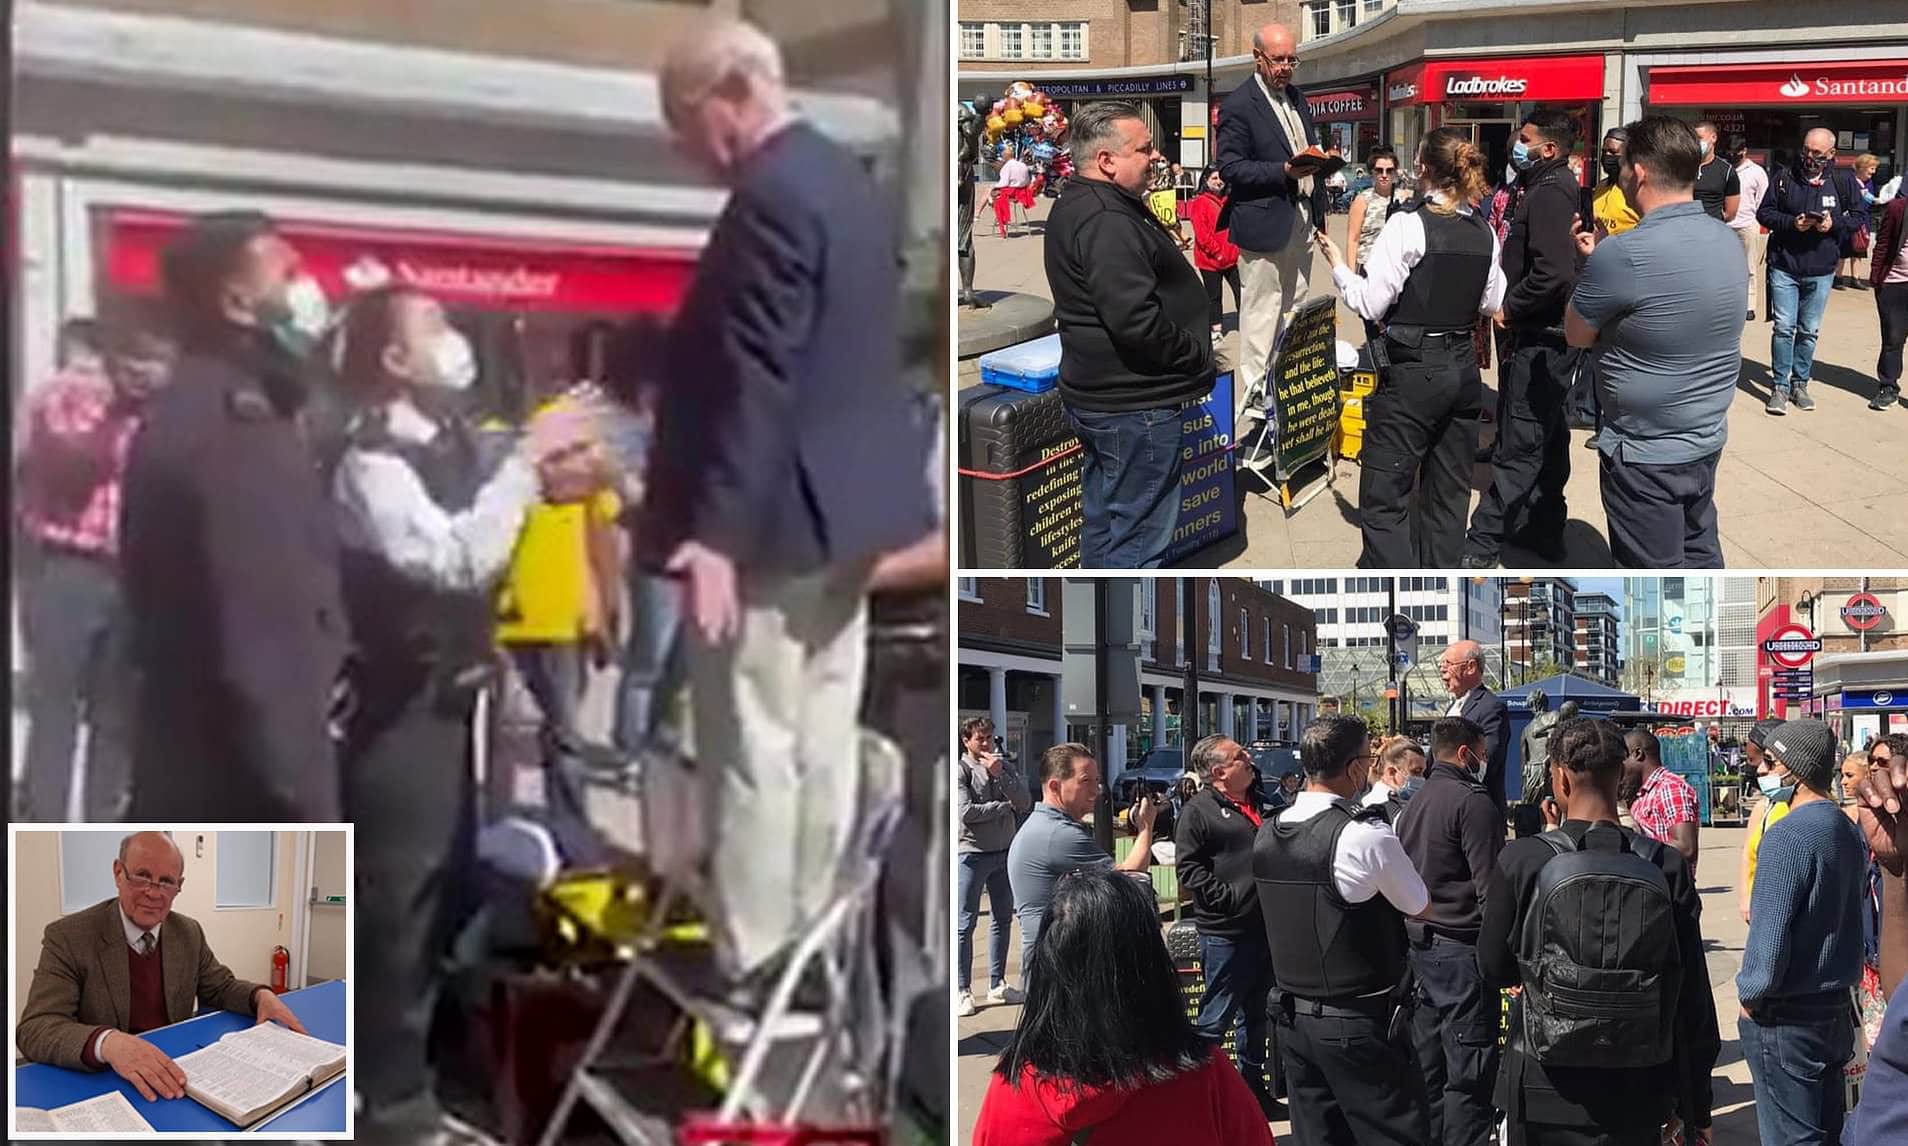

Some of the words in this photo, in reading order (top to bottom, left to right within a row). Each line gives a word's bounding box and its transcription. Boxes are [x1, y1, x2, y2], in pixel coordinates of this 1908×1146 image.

[1033, 85, 1089, 94] ETROPOLITAN
[1107, 82, 1150, 93] PICCADILLY
[1156, 80, 1177, 91] LINES
[1446, 75, 1527, 94] Ladbrokes
[1328, 99, 1363, 114] COFFEE
[1284, 362, 1299, 380] and
[1299, 360, 1312, 374] the
[1312, 355, 1326, 370] life:
[1278, 387, 1290, 400] he
[1289, 381, 1305, 397] that
[1304, 368, 1337, 390] believeth
[1287, 403, 1296, 417] in
[1297, 400, 1312, 413] me,
[1299, 414, 1317, 429] were
[1183, 414, 1213, 434] sus
[1183, 447, 1194, 460] e
[1198, 433, 1229, 455] into
[1281, 437, 1294, 456] yet
[1296, 427, 1315, 443] shall
[1046, 465, 1057, 476] in
[1182, 454, 1228, 486] world
[1026, 470, 1079, 504] redefining
[1038, 484, 1082, 514] exposing
[1182, 486, 1220, 512] save
[1030, 506, 1072, 536] children
[1041, 516, 1084, 548] lifestyles
[1174, 510, 1222, 542] nners
[1051, 536, 1077, 558] knife
